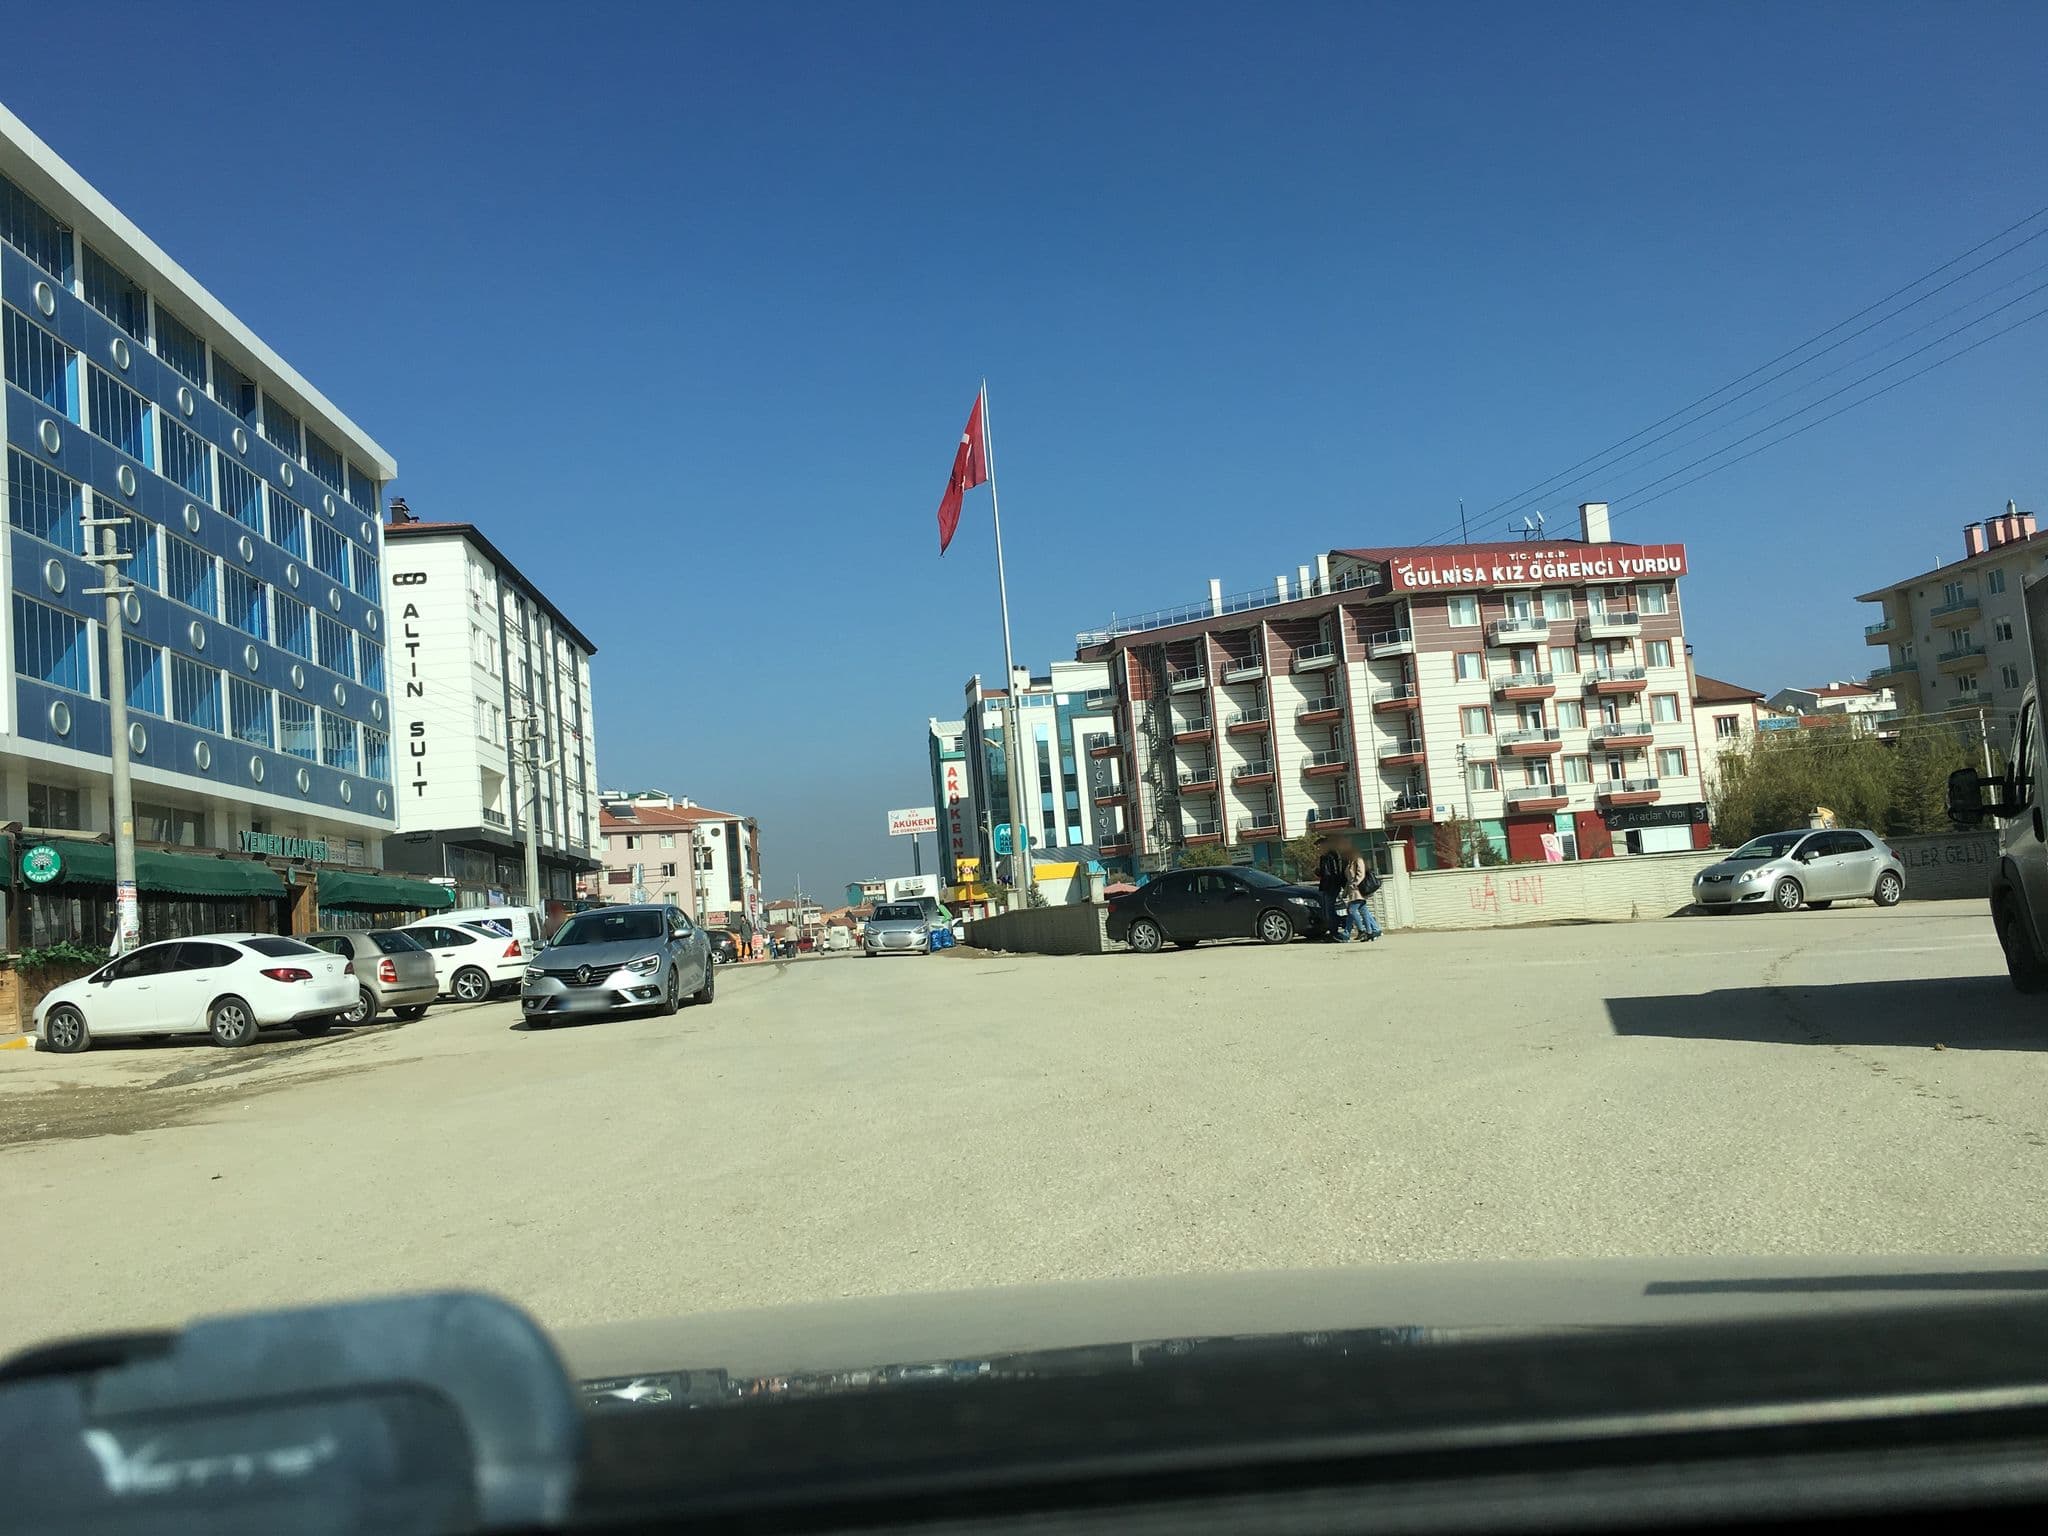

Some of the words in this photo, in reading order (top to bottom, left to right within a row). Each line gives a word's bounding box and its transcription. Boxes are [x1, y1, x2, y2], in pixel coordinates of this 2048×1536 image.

[1403, 561, 1485, 587] GÜLNİSA
[1492, 565, 1525, 581] KIZ
[1529, 556, 1613, 580] ÖĞRENCİ
[1619, 557, 1681, 574] YURDU
[402, 602, 424, 698] ALTIN
[409, 722, 428, 797] SUIT
[1628, 811, 1662, 822] Araçlar
[26, 846, 57, 858] YEMEN
[240, 830, 282, 855] YEMEN
